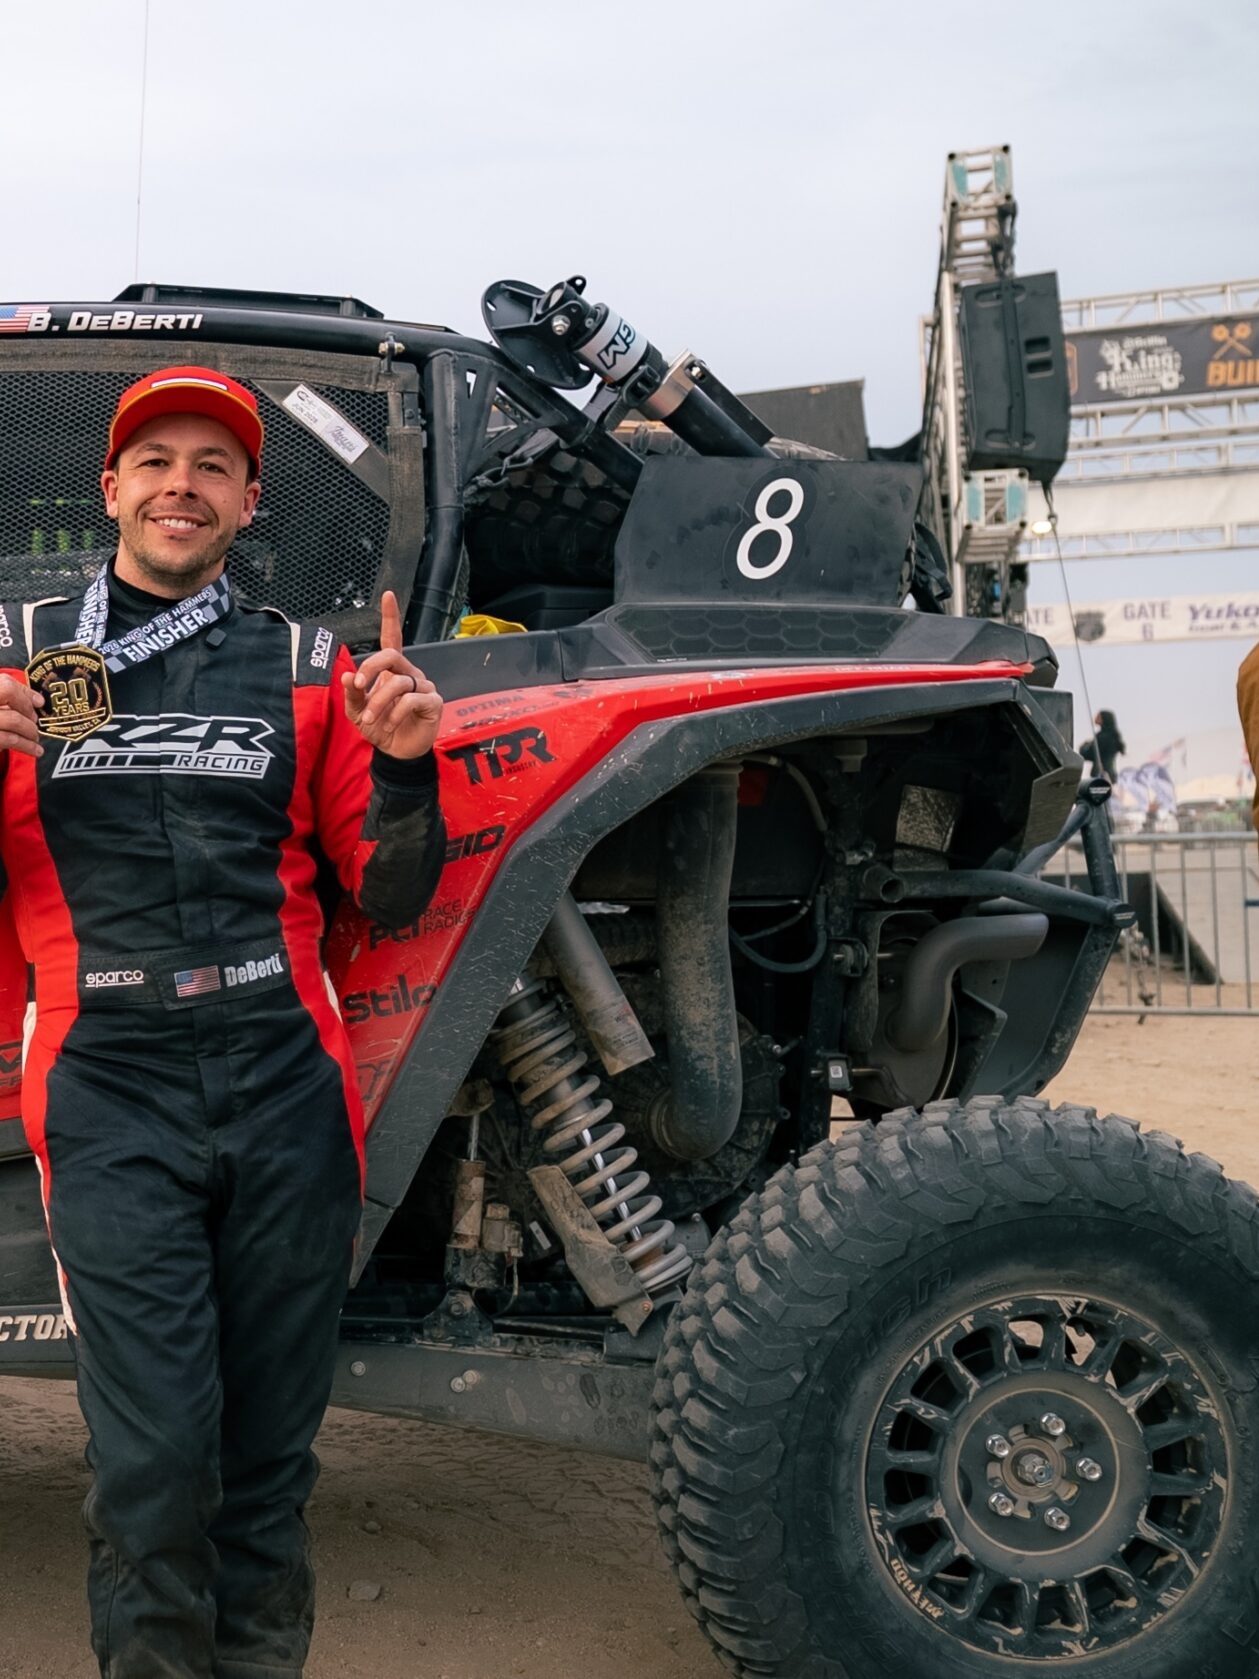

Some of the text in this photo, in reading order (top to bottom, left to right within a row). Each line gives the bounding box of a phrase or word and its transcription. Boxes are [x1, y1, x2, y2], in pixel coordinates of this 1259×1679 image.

[28, 311, 60, 333] B.
[736, 477, 804, 580] 8
[118, 630, 141, 647] KING
[142, 622, 155, 634] OF
[154, 612, 172, 628] THE
[173, 589, 212, 617] HAMMERS
[1123, 601, 1172, 621] GATE
[123, 608, 209, 662] FINISHER
[48, 678, 89, 707] 20
[52, 701, 90, 717] YEARS
[176, 755, 265, 772] RACING
[85, 969, 145, 988] sparco
[223, 953, 285, 988] DeBerti
